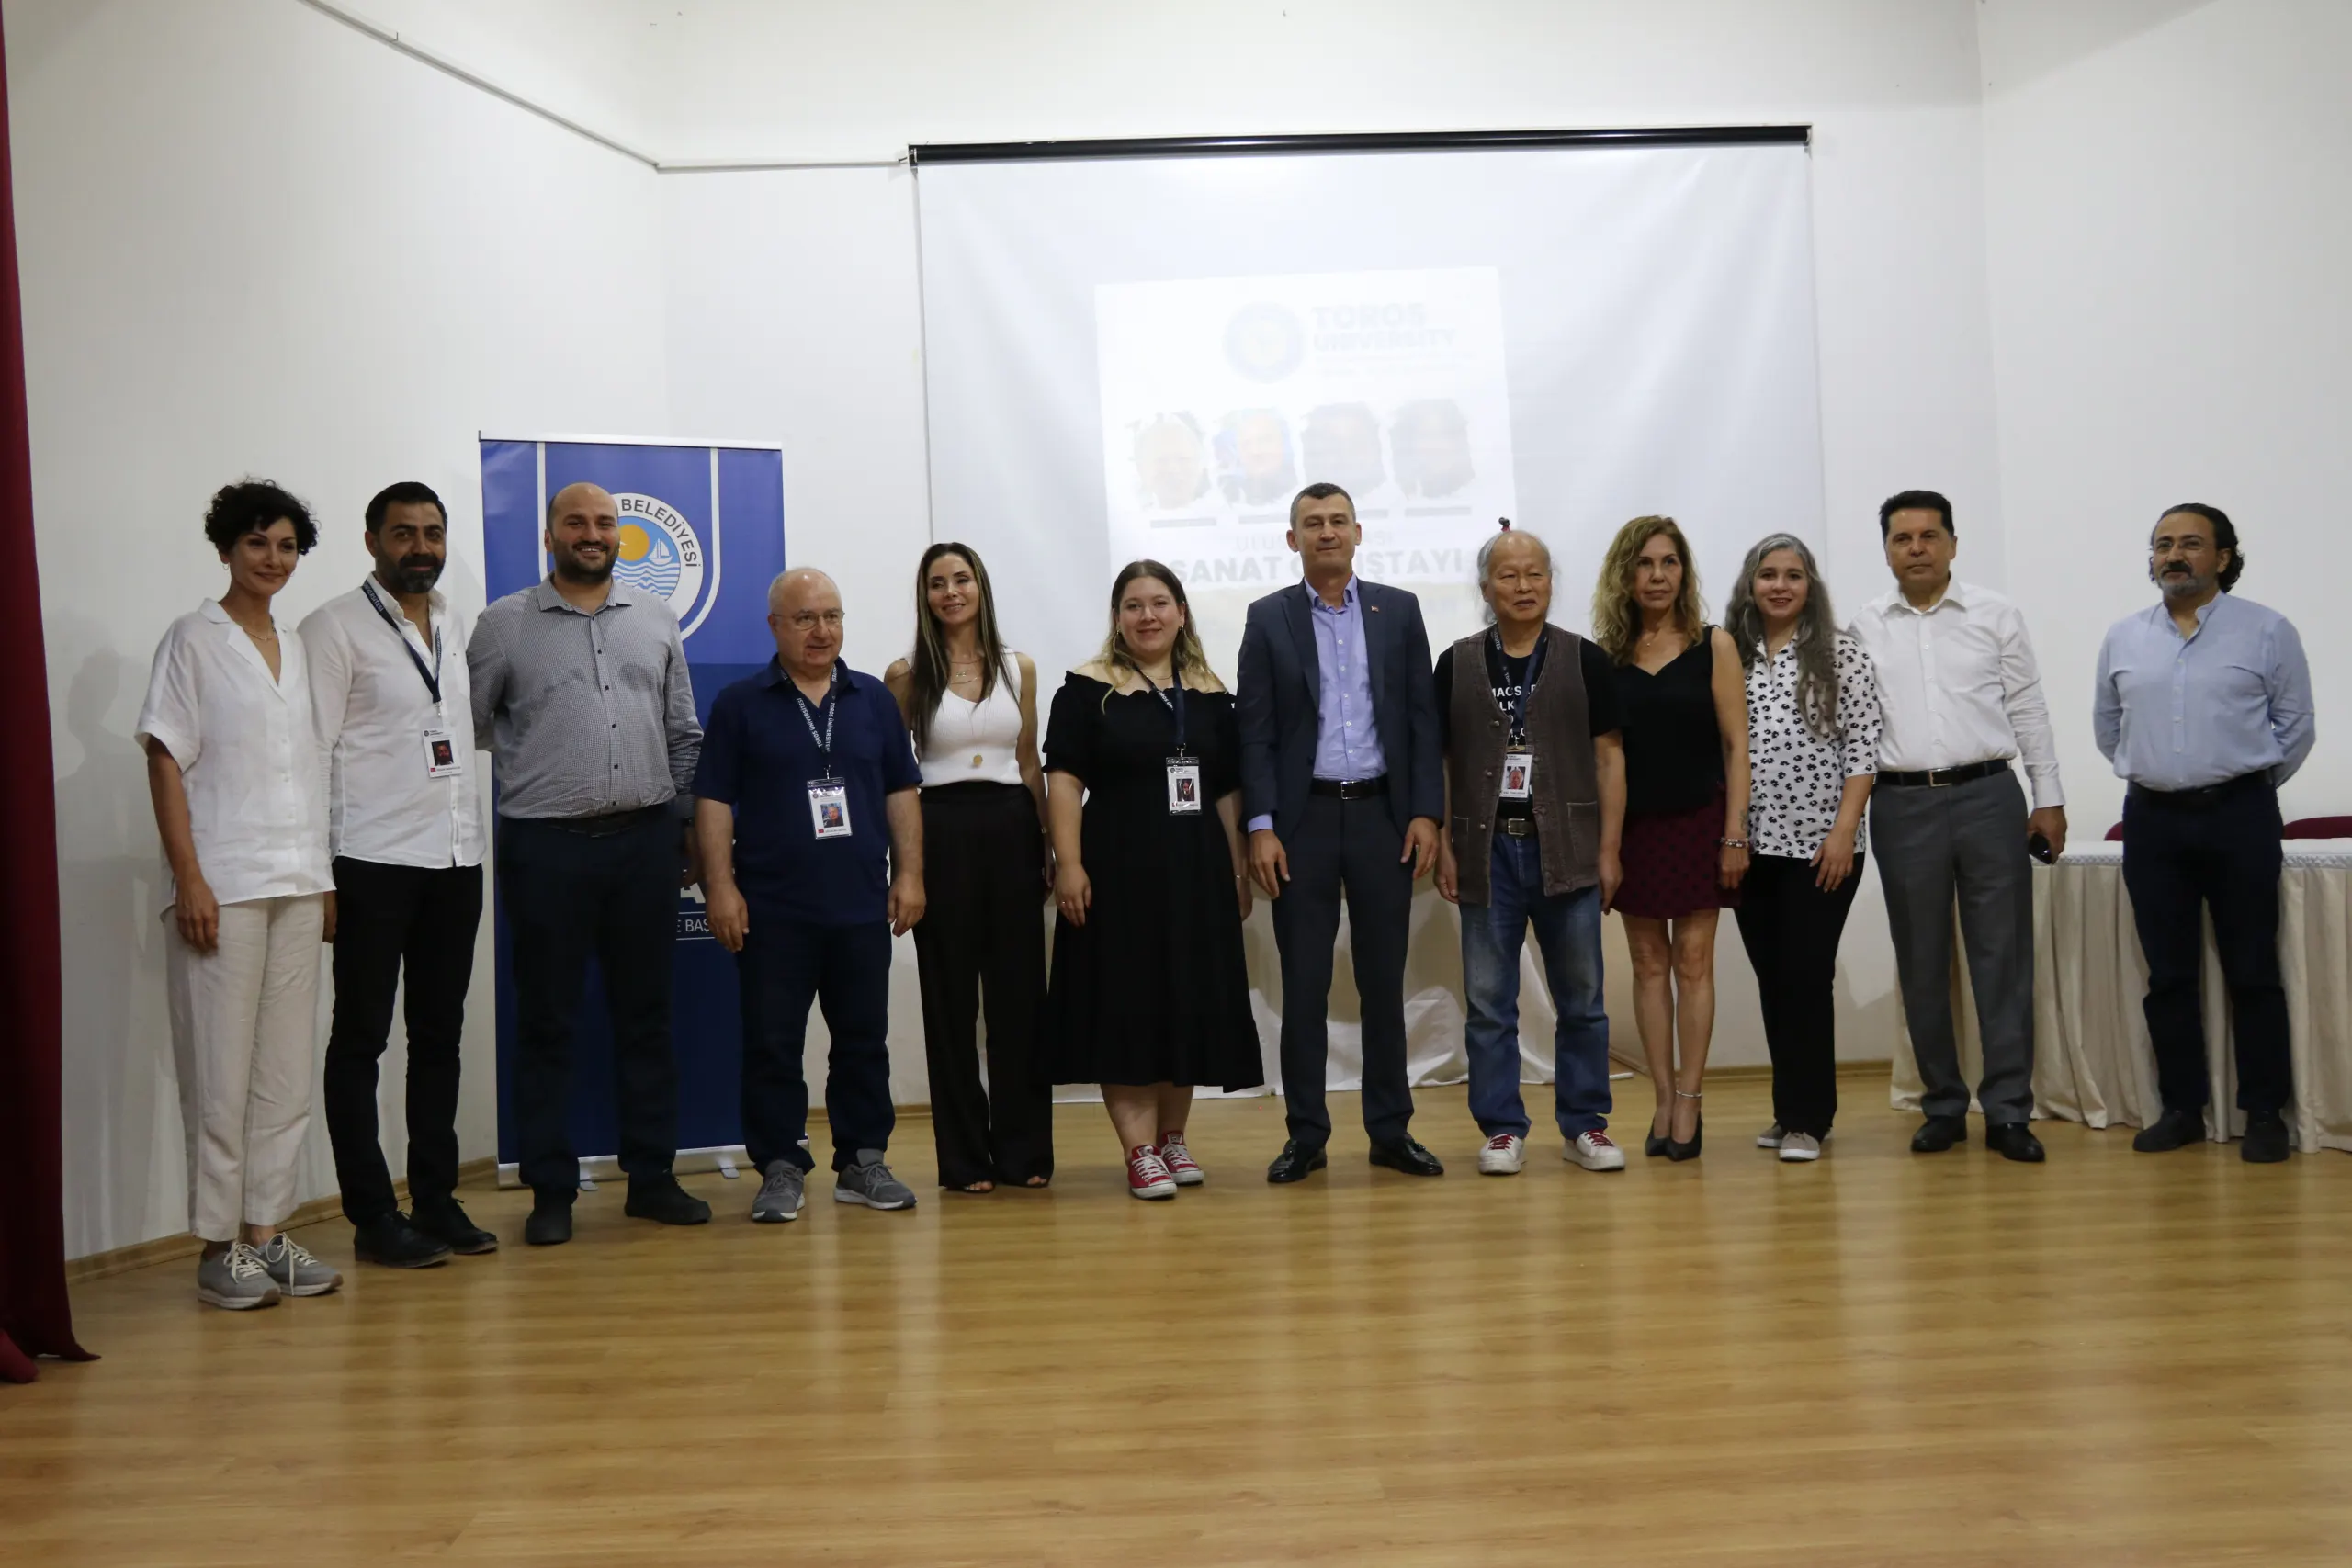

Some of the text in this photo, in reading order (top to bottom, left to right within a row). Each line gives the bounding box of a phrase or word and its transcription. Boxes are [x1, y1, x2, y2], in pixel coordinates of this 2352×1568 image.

[1310, 301, 1426, 329] TOROS
[1313, 327, 1455, 351] UNIVERSITY
[621, 498, 701, 567] BELEDİYESİ
[1169, 556, 1283, 583] SANAT
[812, 730, 823, 748] TOROS
